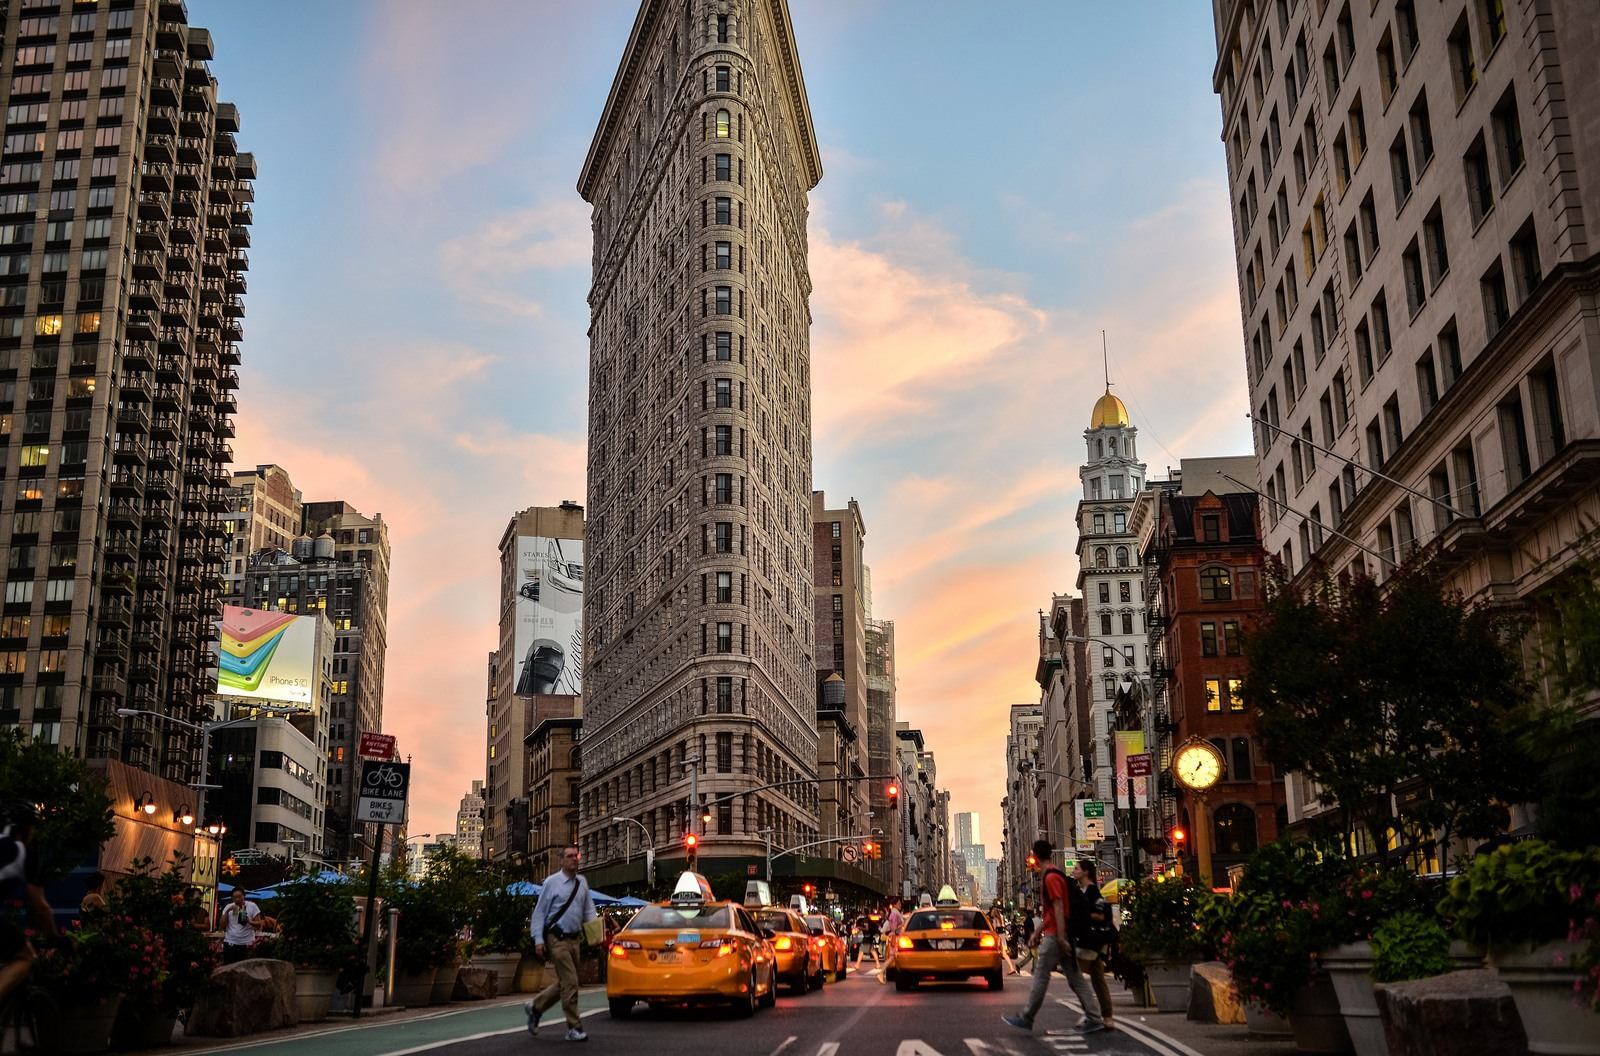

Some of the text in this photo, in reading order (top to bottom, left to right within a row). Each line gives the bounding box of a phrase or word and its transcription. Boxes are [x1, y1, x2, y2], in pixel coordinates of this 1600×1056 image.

[270, 675, 293, 686] iPhone
[371, 734, 393, 743] STOPPING
[365, 741, 388, 749] ANYTIME
[362, 787, 404, 798] BIKE LANE
[369, 801, 393, 810] BIKES
[369, 810, 391, 820] ONLY
